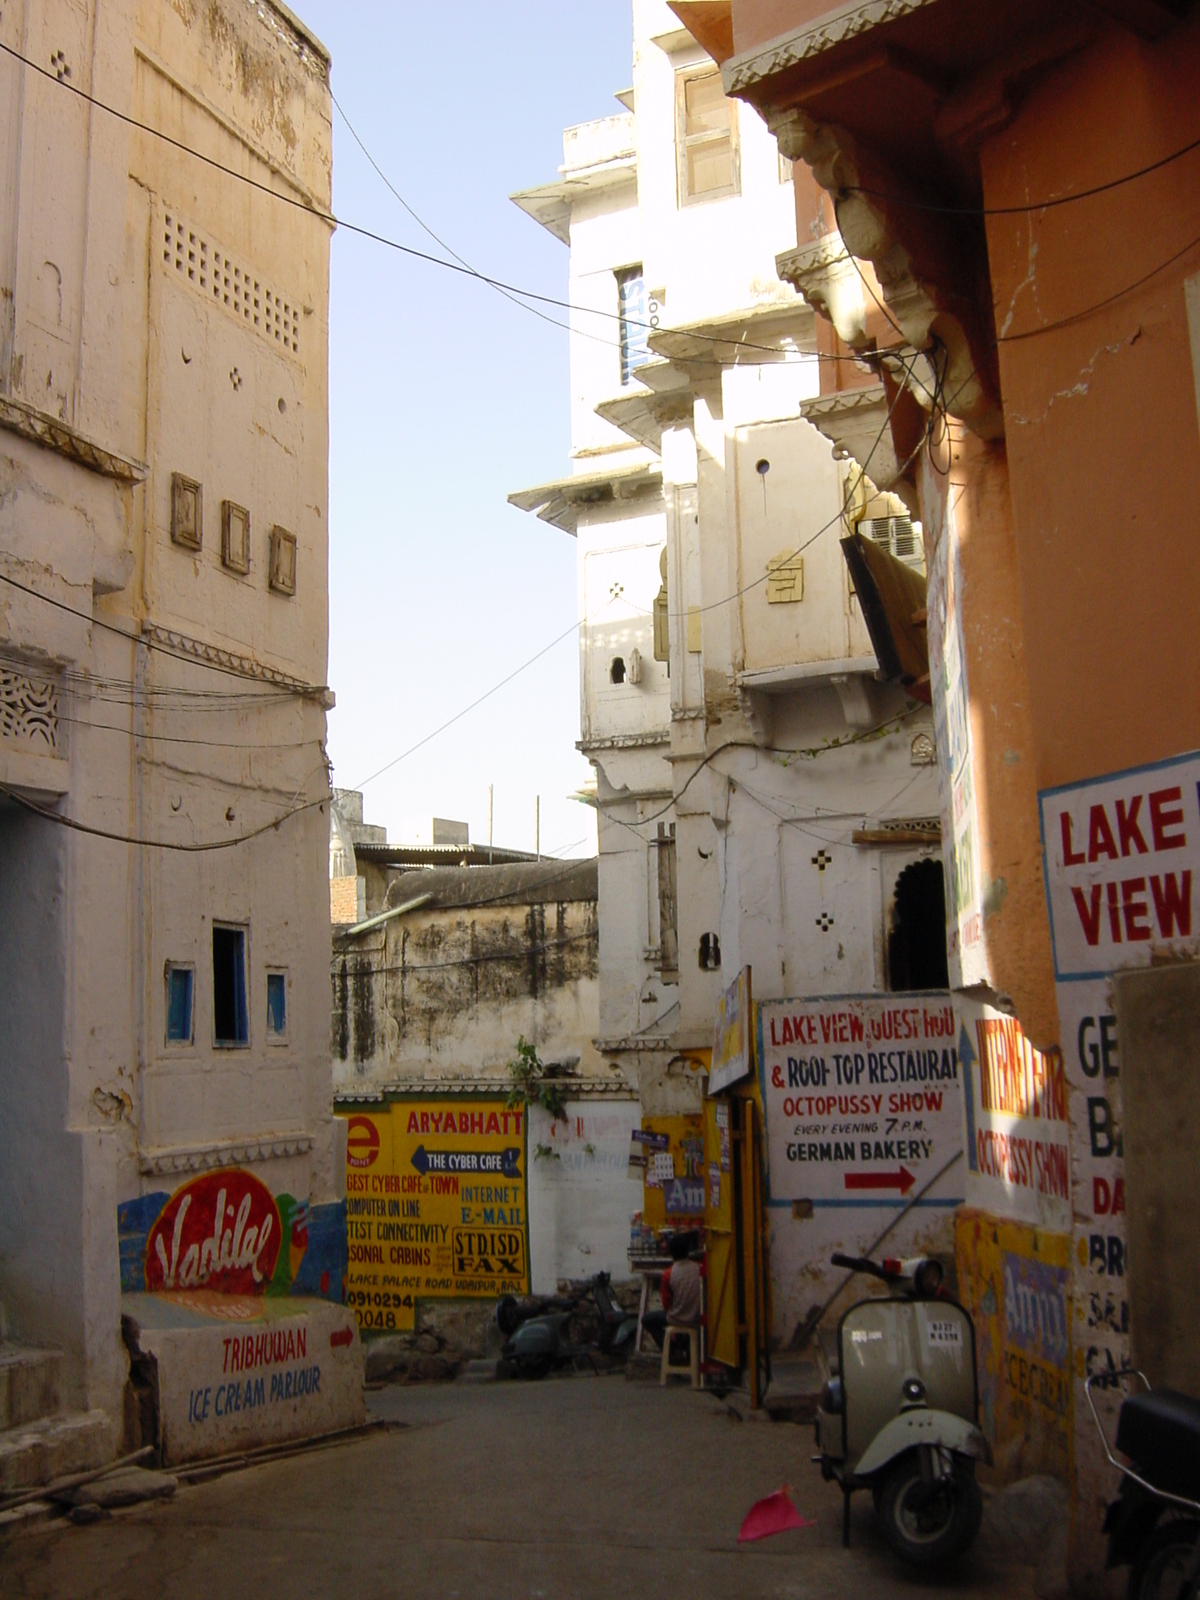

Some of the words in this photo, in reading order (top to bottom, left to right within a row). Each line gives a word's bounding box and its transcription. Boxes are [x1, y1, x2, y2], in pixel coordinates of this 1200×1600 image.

[1060, 786, 1187, 867] LAKE
[1071, 870, 1192, 946] VIEW
[770, 1015, 817, 1047] LAKE
[818, 1012, 864, 1045] VIEW
[870, 1008, 919, 1042] GUEST
[771, 1065, 786, 1089] &
[787, 1056, 830, 1088] ROOF
[833, 1053, 865, 1085] TOP
[783, 1094, 883, 1117] OCTOPUSSY
[888, 1091, 943, 1113] SHOW
[407, 1111, 523, 1136] ARYABHATT
[794, 1123, 828, 1136] EVERY
[831, 1122, 879, 1135] EVENING
[885, 1118, 898, 1135] 7
[901, 1120, 927, 1133] P.M.
[1087, 1097, 1123, 1158] B
[350, 1157, 370, 1167] POINT
[427, 1154, 446, 1169] THE
[448, 1155, 478, 1170] CYBER
[480, 1155, 502, 1170] CAFE
[786, 1141, 855, 1162] GERMAN
[860, 1139, 933, 1160] BAKERY
[978, 1128, 1034, 1190] OCTOPUSSY
[1034, 1140, 1070, 1201] SHOW
[372, 1175, 400, 1193] CYBER
[401, 1175, 422, 1194] CAFE
[429, 1176, 459, 1195] TOWN
[461, 1186, 519, 1204] INTERNET
[346, 1198, 386, 1216] OMPUTER
[388, 1200, 400, 1217] ON
[402, 1200, 420, 1218] LINE
[461, 1206, 525, 1225] E-MAIL
[155, 1188, 272, 1288] Vadilal
[346, 1221, 373, 1239] TEST
[377, 1222, 449, 1244] CONNECTIVITY
[347, 1244, 384, 1264] SONAL
[390, 1246, 431, 1267] CABINS
[457, 1257, 522, 1274] FAX
[1090, 1235, 1126, 1277] BR
[350, 1273, 378, 1286] LAKE
[383, 1276, 421, 1288] PALACE
[425, 1278, 452, 1290] ROAD
[223, 1328, 306, 1373] TRIBHUWAN
[189, 1387, 211, 1423] ICE
[214, 1376, 265, 1417] CREAM
[270, 1365, 321, 1404] PARLOUR
